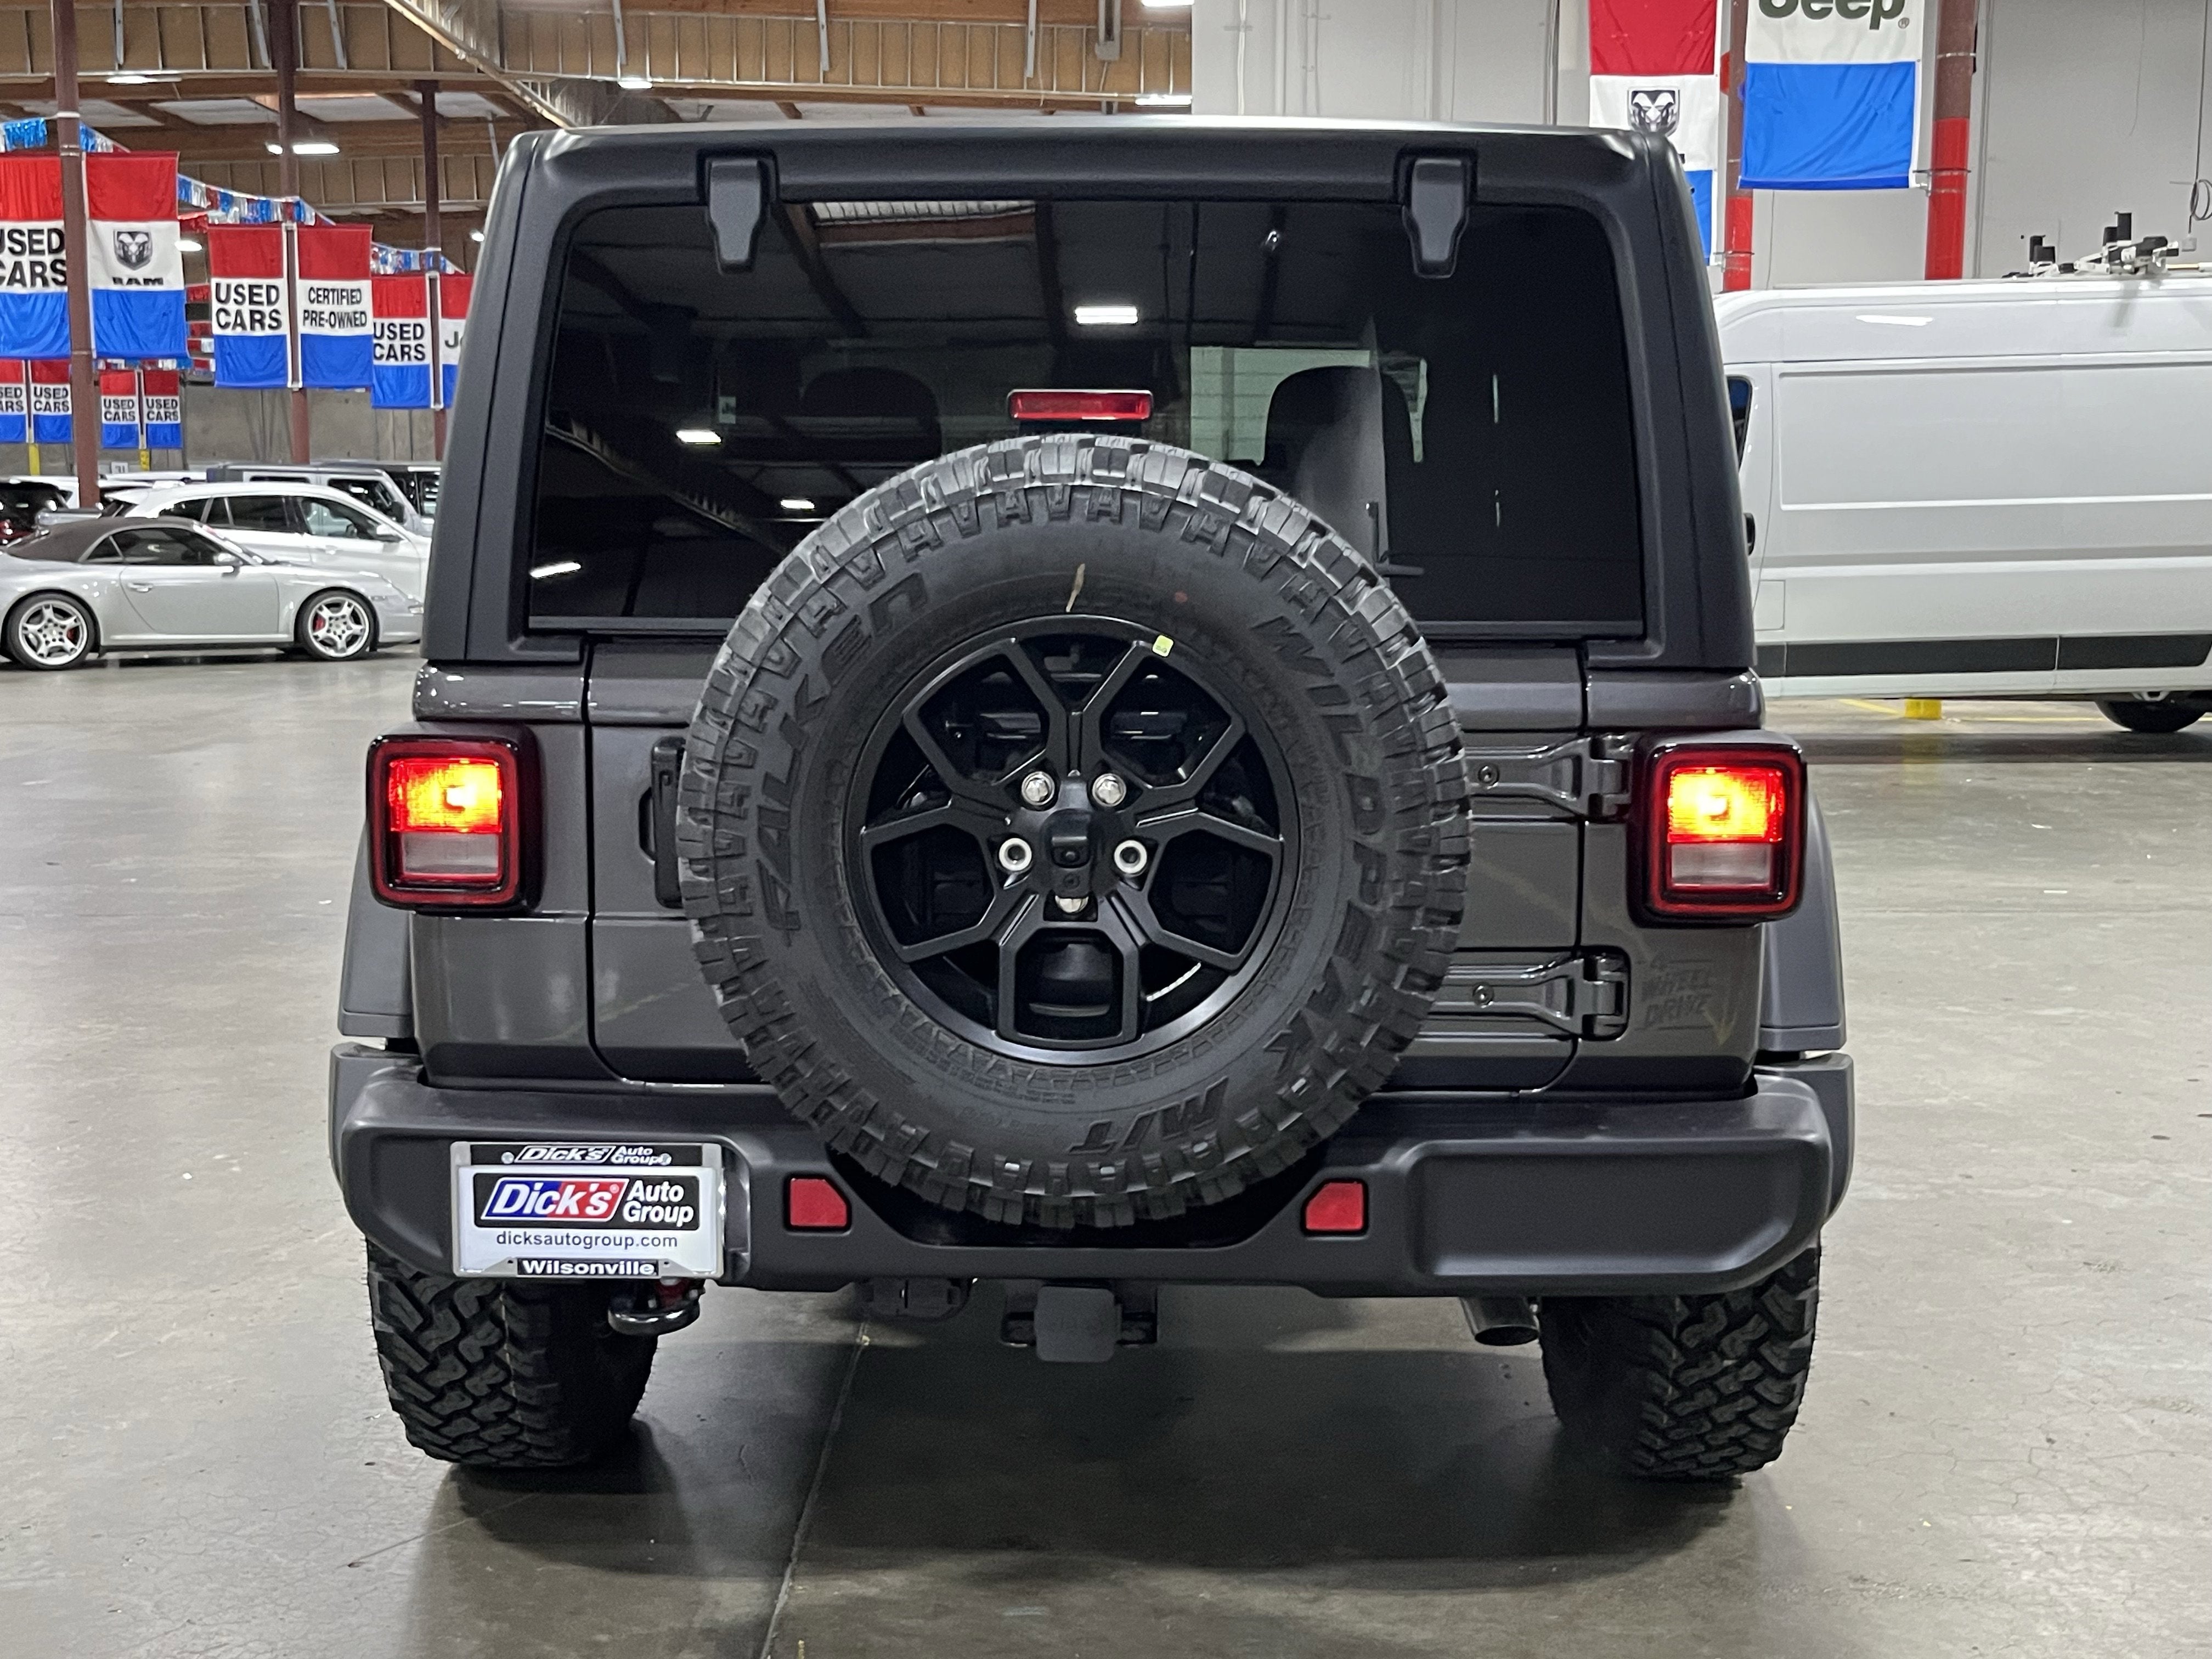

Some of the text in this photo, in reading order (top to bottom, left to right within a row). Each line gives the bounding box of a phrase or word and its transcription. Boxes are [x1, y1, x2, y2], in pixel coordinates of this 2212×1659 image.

[0, 228, 64, 256] SED
[0, 259, 66, 287] ARS
[215, 282, 280, 306] USED
[308, 287, 362, 305] CERTIFIED
[216, 308, 282, 331] CARS
[303, 309, 367, 329] PRE-OWNED
[374, 322, 425, 340] USED
[374, 343, 425, 361] CARS
[34, 386, 69, 399] USED
[34, 400, 69, 412] CARS
[104, 398, 134, 409] USED
[146, 398, 178, 409] USED
[104, 410, 136, 421] CARS
[146, 411, 178, 421] CARS
[617, 1146, 653, 1155] Auto
[627, 1180, 685, 1201] Auto
[623, 1201, 695, 1227] Group
[496, 1231, 678, 1250] dicksautogroup.com
[522, 1260, 654, 1276] Wilsonville
